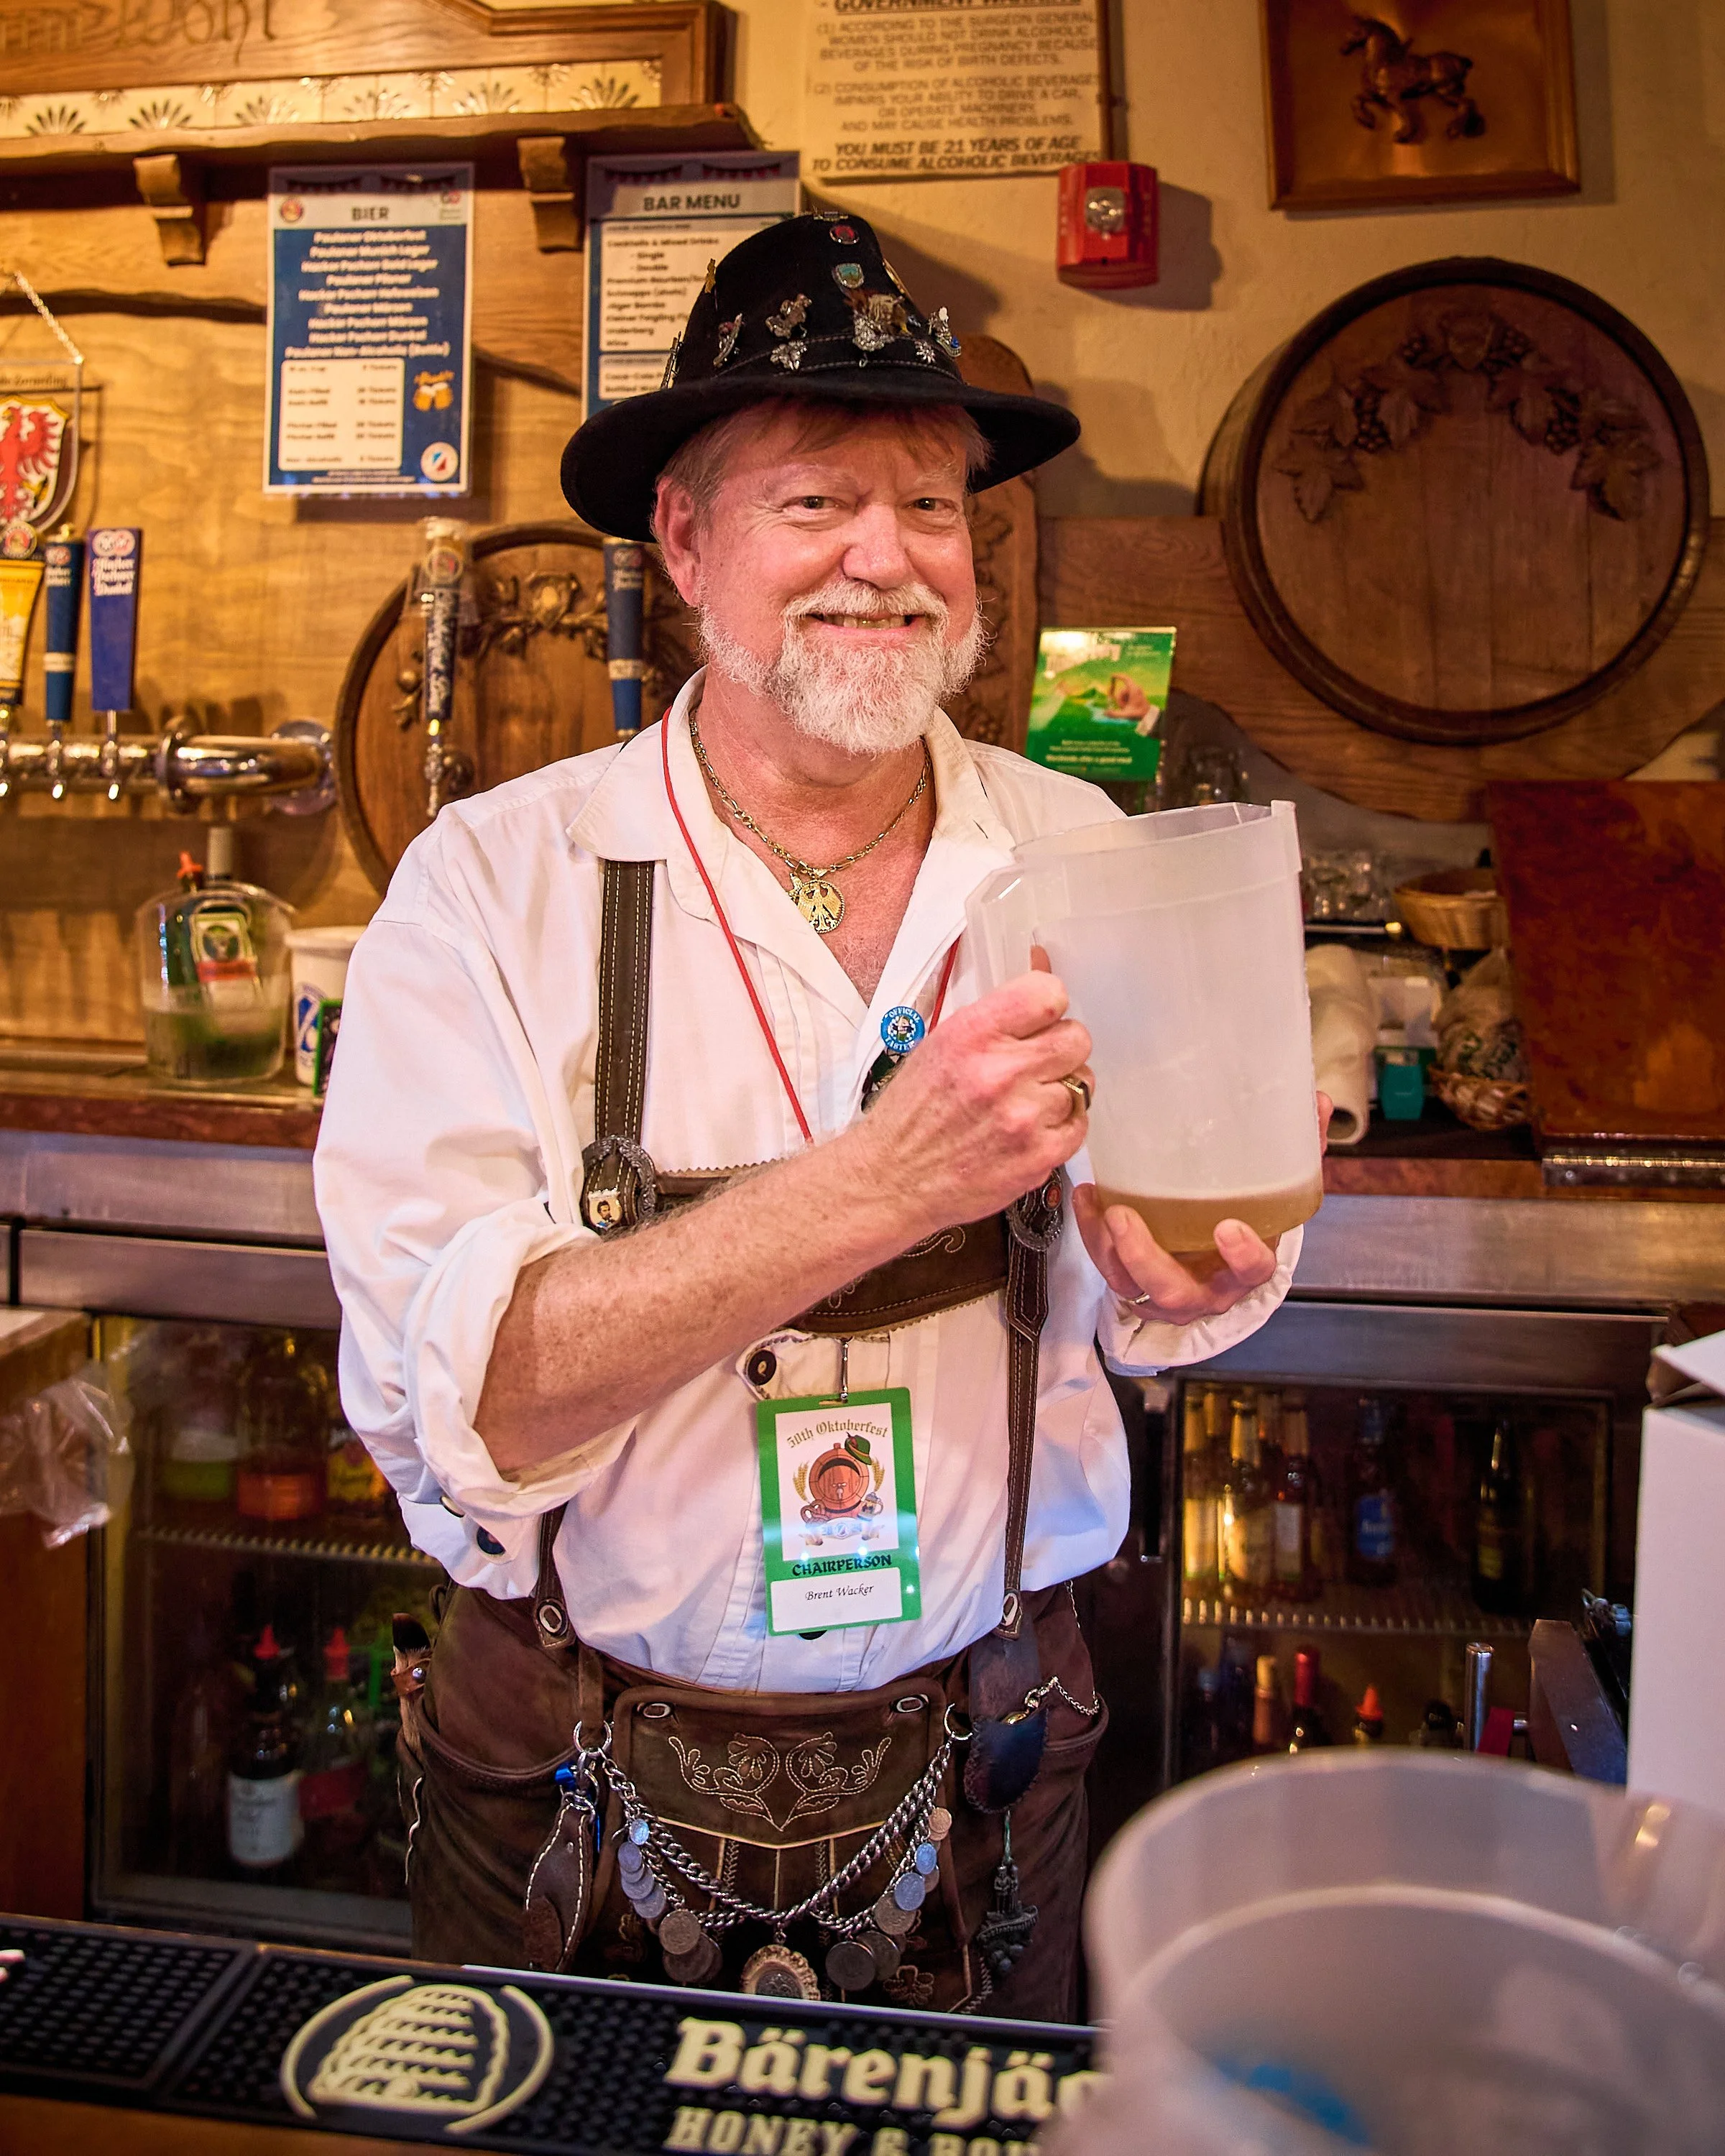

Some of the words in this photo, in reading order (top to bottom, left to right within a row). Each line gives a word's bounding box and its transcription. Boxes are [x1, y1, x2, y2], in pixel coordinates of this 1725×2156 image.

[835, 142, 867, 156] YOU
[870, 141, 915, 155] MUST
[918, 140, 939, 155] BE
[942, 139, 964, 154] 21
[970, 137, 1021, 152] YEARS
[1024, 135, 1046, 150] OF
[813, 157, 832, 171] TO
[835, 157, 912, 171] CONSUME
[916, 155, 1007, 170] ALCOHOLIC
[643, 195, 682, 211] BAR
[685, 193, 741, 210] MENU
[351, 206, 390, 221] BIER
[885, 1035, 916, 1051] TASTER
[786, 1427, 814, 1448] 50th
[815, 1419, 888, 1438] Oktoberfest
[792, 1554, 892, 1577] CHAIRPERSON
[804, 1590, 834, 1600] Brent
[836, 1583, 874, 1596] Wacker
[661, 2106, 860, 2156] HONEY
